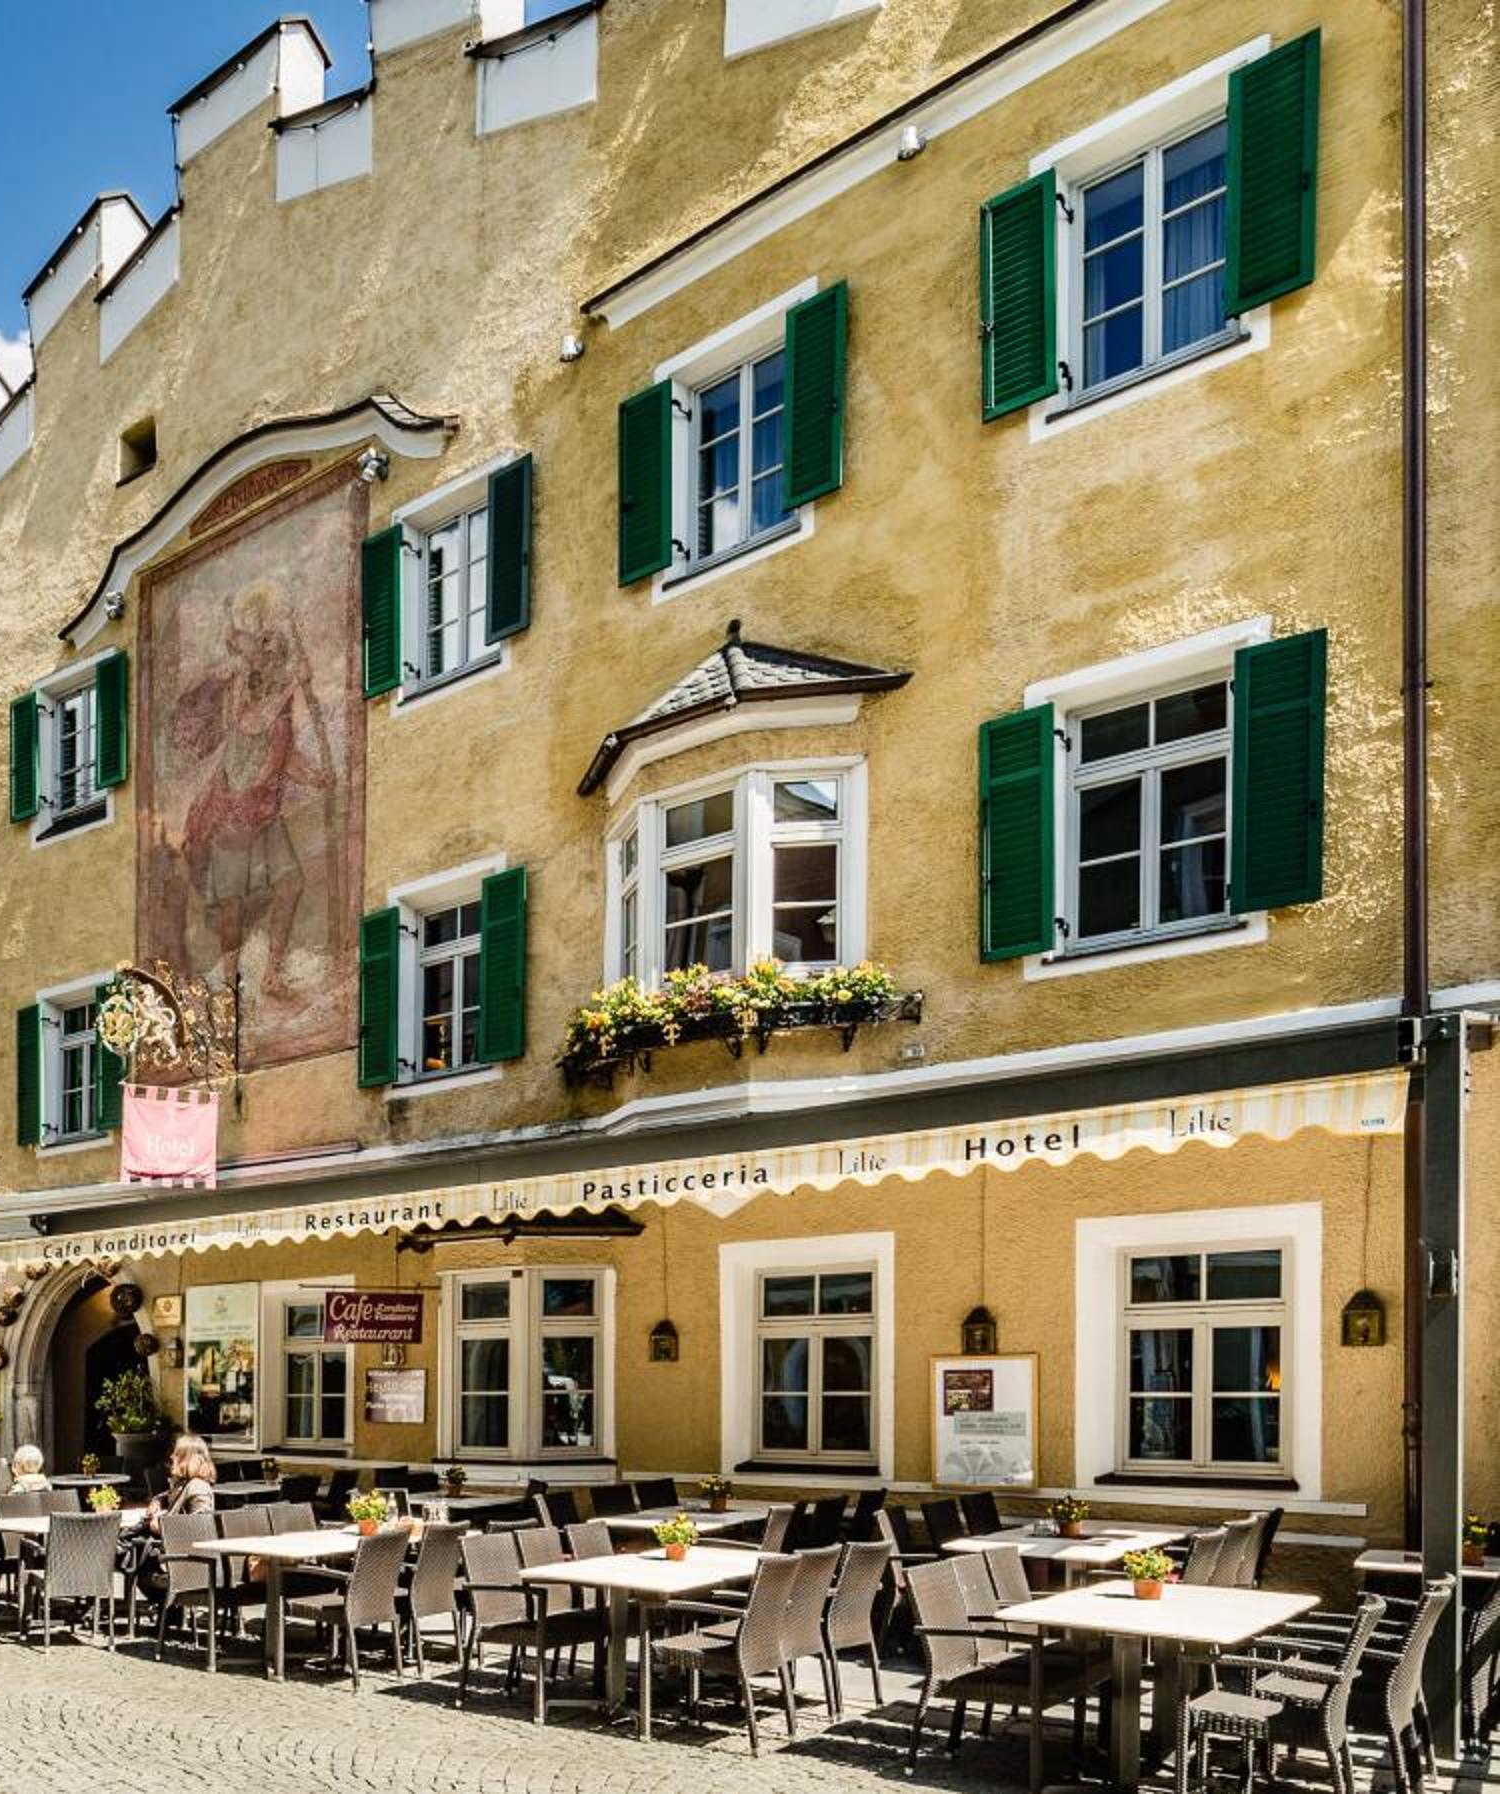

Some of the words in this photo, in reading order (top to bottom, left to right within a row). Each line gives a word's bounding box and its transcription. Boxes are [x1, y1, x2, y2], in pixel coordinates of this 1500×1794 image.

[147, 1135, 196, 1158] Hotel
[43, 1241, 81, 1259] Cafe
[93, 1228, 197, 1254] Konditorei
[305, 1202, 443, 1230] Restaurant
[493, 1188, 527, 1211] Lilie
[583, 1164, 768, 1201] Pasticceria
[839, 1150, 887, 1175] Lilie
[965, 1125, 1080, 1161] Hotel
[1169, 1109, 1232, 1138] Lilie
[333, 1324, 414, 1343] Restaurant
